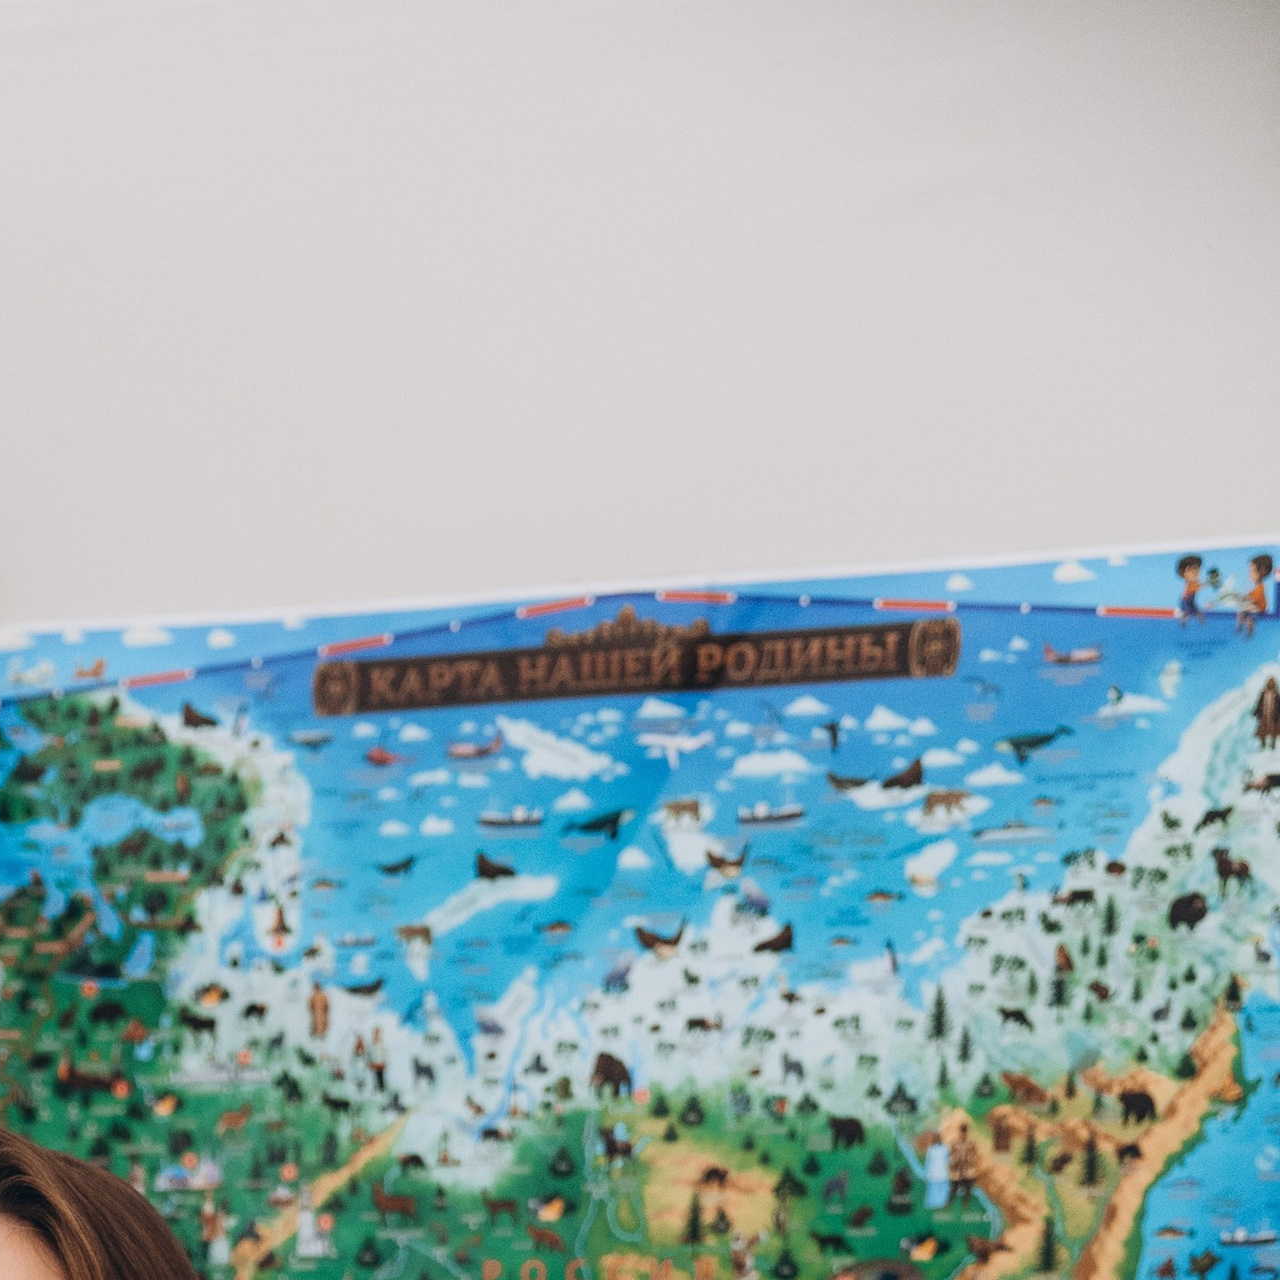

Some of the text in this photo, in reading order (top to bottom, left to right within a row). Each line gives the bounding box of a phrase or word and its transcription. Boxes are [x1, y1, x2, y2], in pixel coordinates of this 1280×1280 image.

[369, 630, 900, 701] КАРТА НАШЕЙ РОДИНЫ
